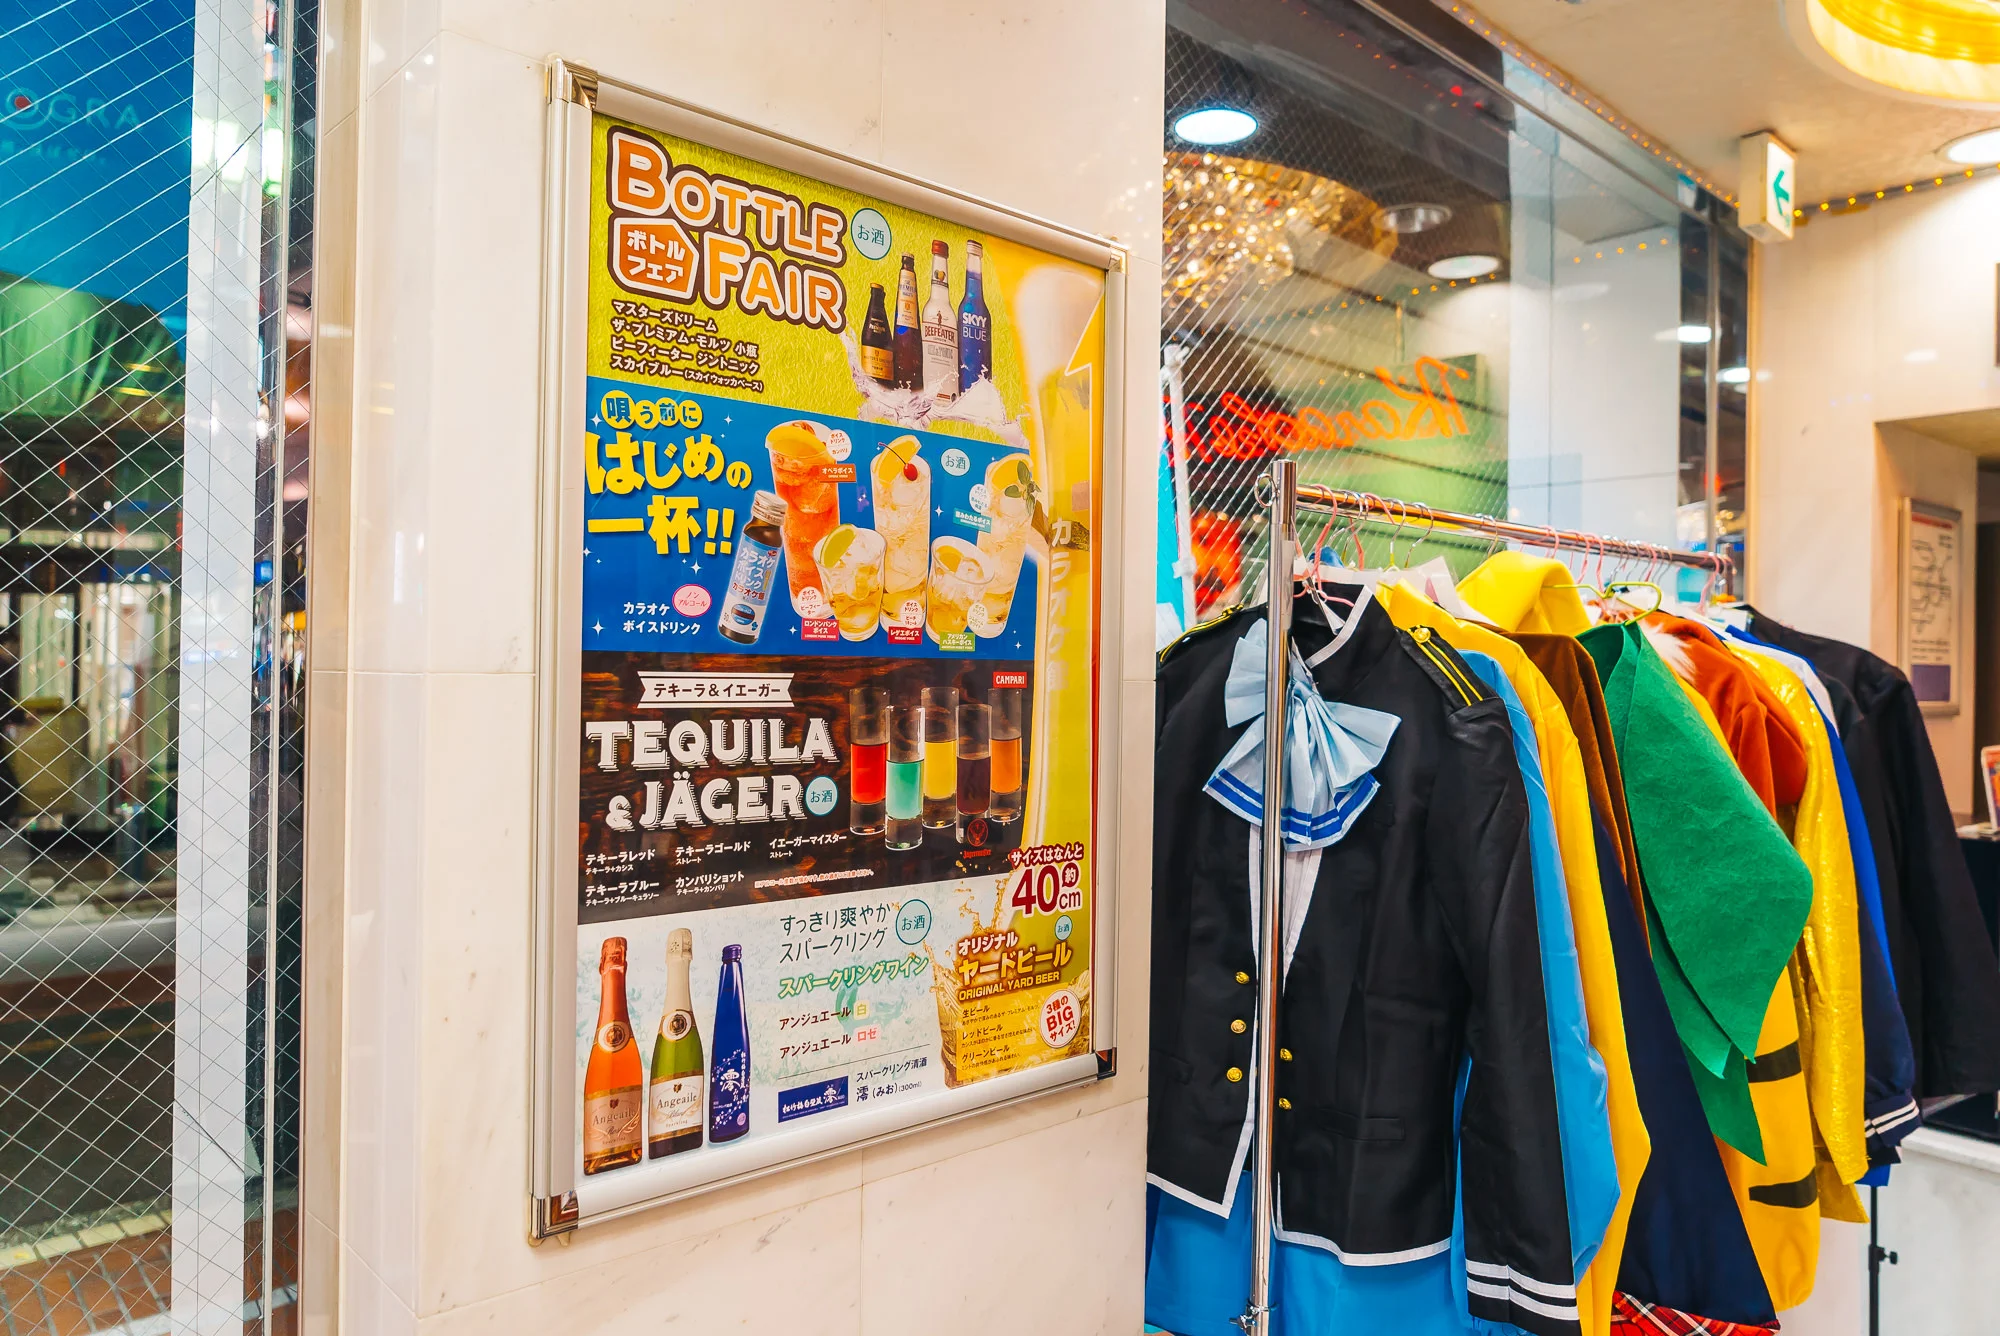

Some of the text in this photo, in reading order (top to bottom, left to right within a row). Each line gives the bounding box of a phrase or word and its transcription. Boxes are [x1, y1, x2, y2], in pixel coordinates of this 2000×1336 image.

[609, 127, 846, 266] BOTTLE
[626, 229, 686, 260] ボトル
[857, 225, 885, 246] お酒
[627, 257, 684, 285] フェア
[703, 234, 846, 331] FAIR
[612, 300, 718, 332] マスターズドリーム
[963, 313, 987, 328] SKYY
[611, 318, 759, 359] ザ・プレミアム・モルツ 小瓶
[924, 326, 955, 343] BEEFEATER
[963, 327, 987, 342] BLUE
[611, 335, 760, 376] ビーフィーター ジントニック
[606, 397, 698, 423] 唄う前に
[585, 431, 752, 494] はじめの
[822, 467, 853, 475] オペラボイス
[946, 456, 966, 469] お酒
[587, 495, 735, 554] 一杯!!
[740, 547, 776, 568] カラオケ
[737, 559, 764, 579] ボイス
[623, 601, 670, 616] カラオケ
[677, 599, 708, 608] アルコール
[623, 619, 701, 635] ボイスドリンク
[804, 620, 837, 628] ロンドンパンク
[996, 675, 1025, 684] CAMPARI
[653, 683, 780, 698] テキーラ&イエーガー
[586, 717, 840, 772] TEQUILA
[639, 770, 808, 831] JÄGER
[810, 789, 833, 803] お酒
[675, 840, 751, 858] テキーラゴールド
[769, 833, 847, 849] イエーガーマイスター
[585, 849, 656, 865] テキーラレッド
[675, 857, 702, 865] ストレート
[769, 850, 793, 858] ストレート
[1011, 844, 1084, 866] サイズはなんと
[675, 870, 744, 888] カンパリショット
[1065, 867, 1077, 884] 約
[585, 880, 660, 897] テキーラブルー
[1012, 864, 1082, 915] 40 cm
[780, 904, 892, 937] すっきり爽やか
[901, 915, 926, 931] お酒
[1057, 923, 1070, 934] お酒
[780, 927, 889, 964] スパークリング
[958, 931, 1019, 957] オリジナル
[958, 941, 1073, 986] ヤードビール
[778, 956, 930, 999] スパークリングワイン
[959, 971, 1060, 1001] ORIGINAL YARD BEER
[962, 1005, 990, 1019] 生ビール
[1046, 995, 1069, 1014] 3種の
[780, 1003, 868, 1031] アンジュエール 白
[1046, 1006, 1074, 1032] BIG
[962, 1024, 1003, 1040] レッドビール
[1049, 1020, 1077, 1042] サイズ!
[780, 1027, 878, 1059] アンジュエール ロゼ
[962, 1045, 1010, 1063] グリーンビール
[856, 1056, 928, 1083] スパークリング清酒
[656, 1092, 697, 1109] Angeaile
